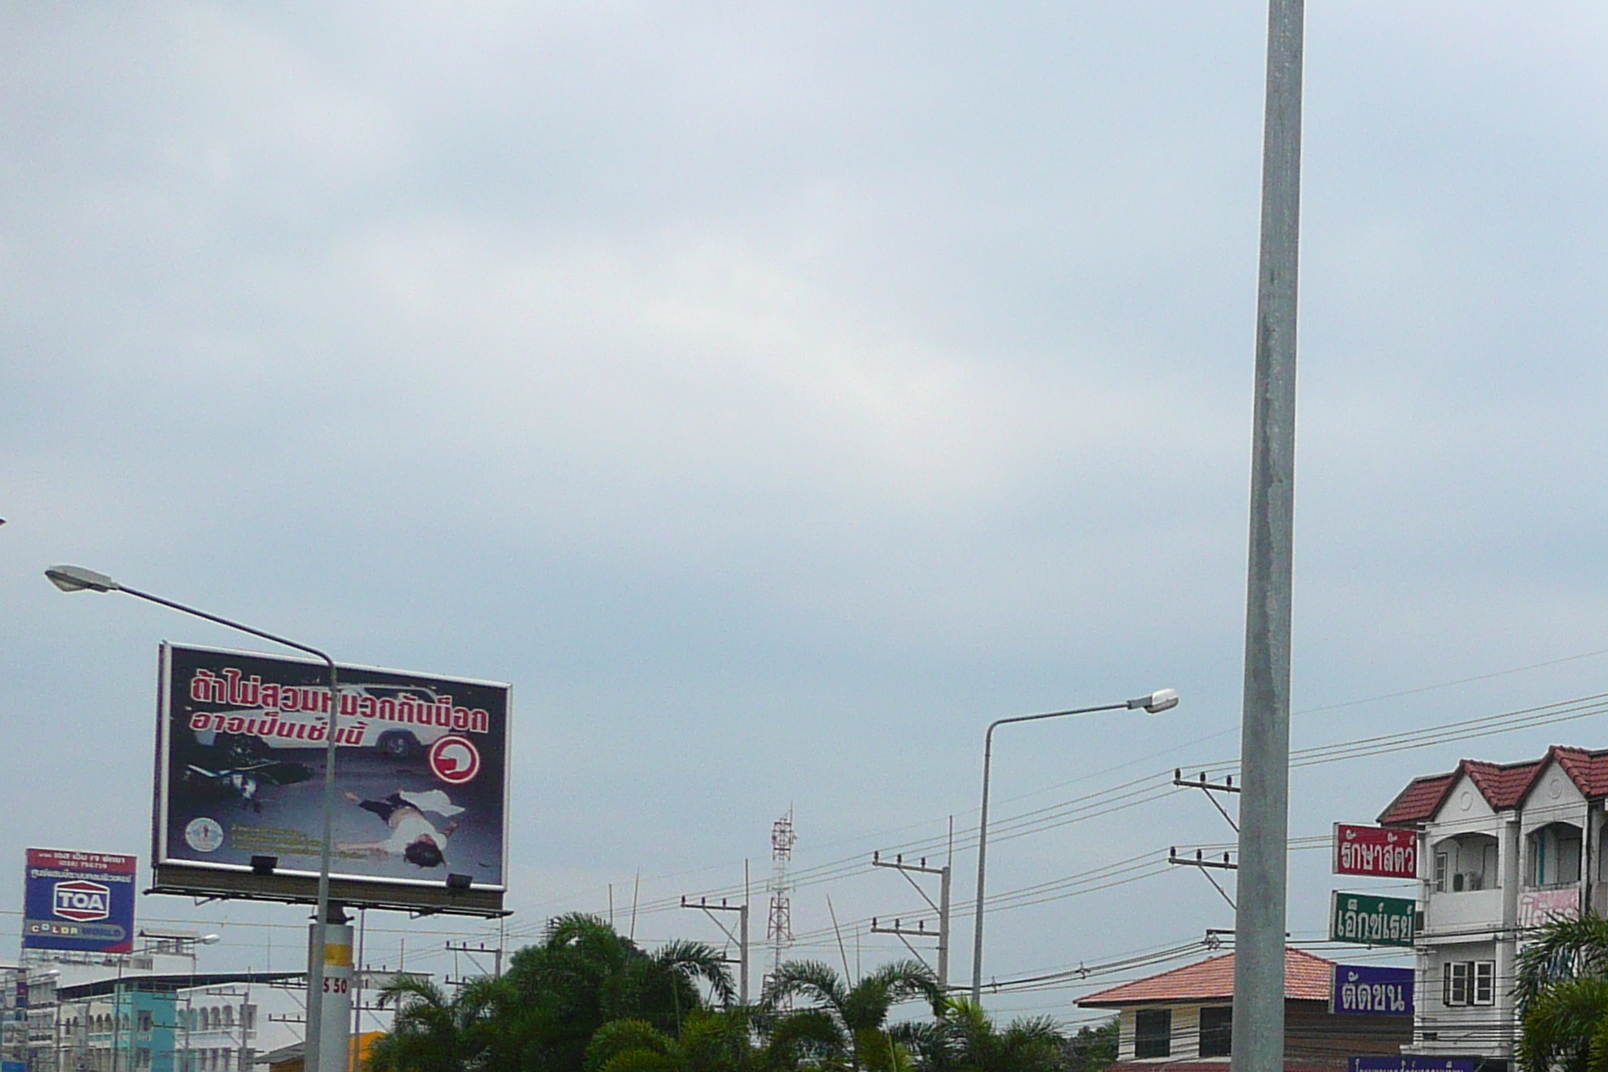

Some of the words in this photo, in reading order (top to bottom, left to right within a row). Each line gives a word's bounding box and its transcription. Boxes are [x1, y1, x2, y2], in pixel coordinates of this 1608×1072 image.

[1341, 829, 1415, 873] รักษาสัตว์
[58, 892, 104, 910] TOA
[31, 923, 78, 935] COLOR
[333, 977, 348, 993] 50
[1341, 971, 1405, 1012] ตัดขน
